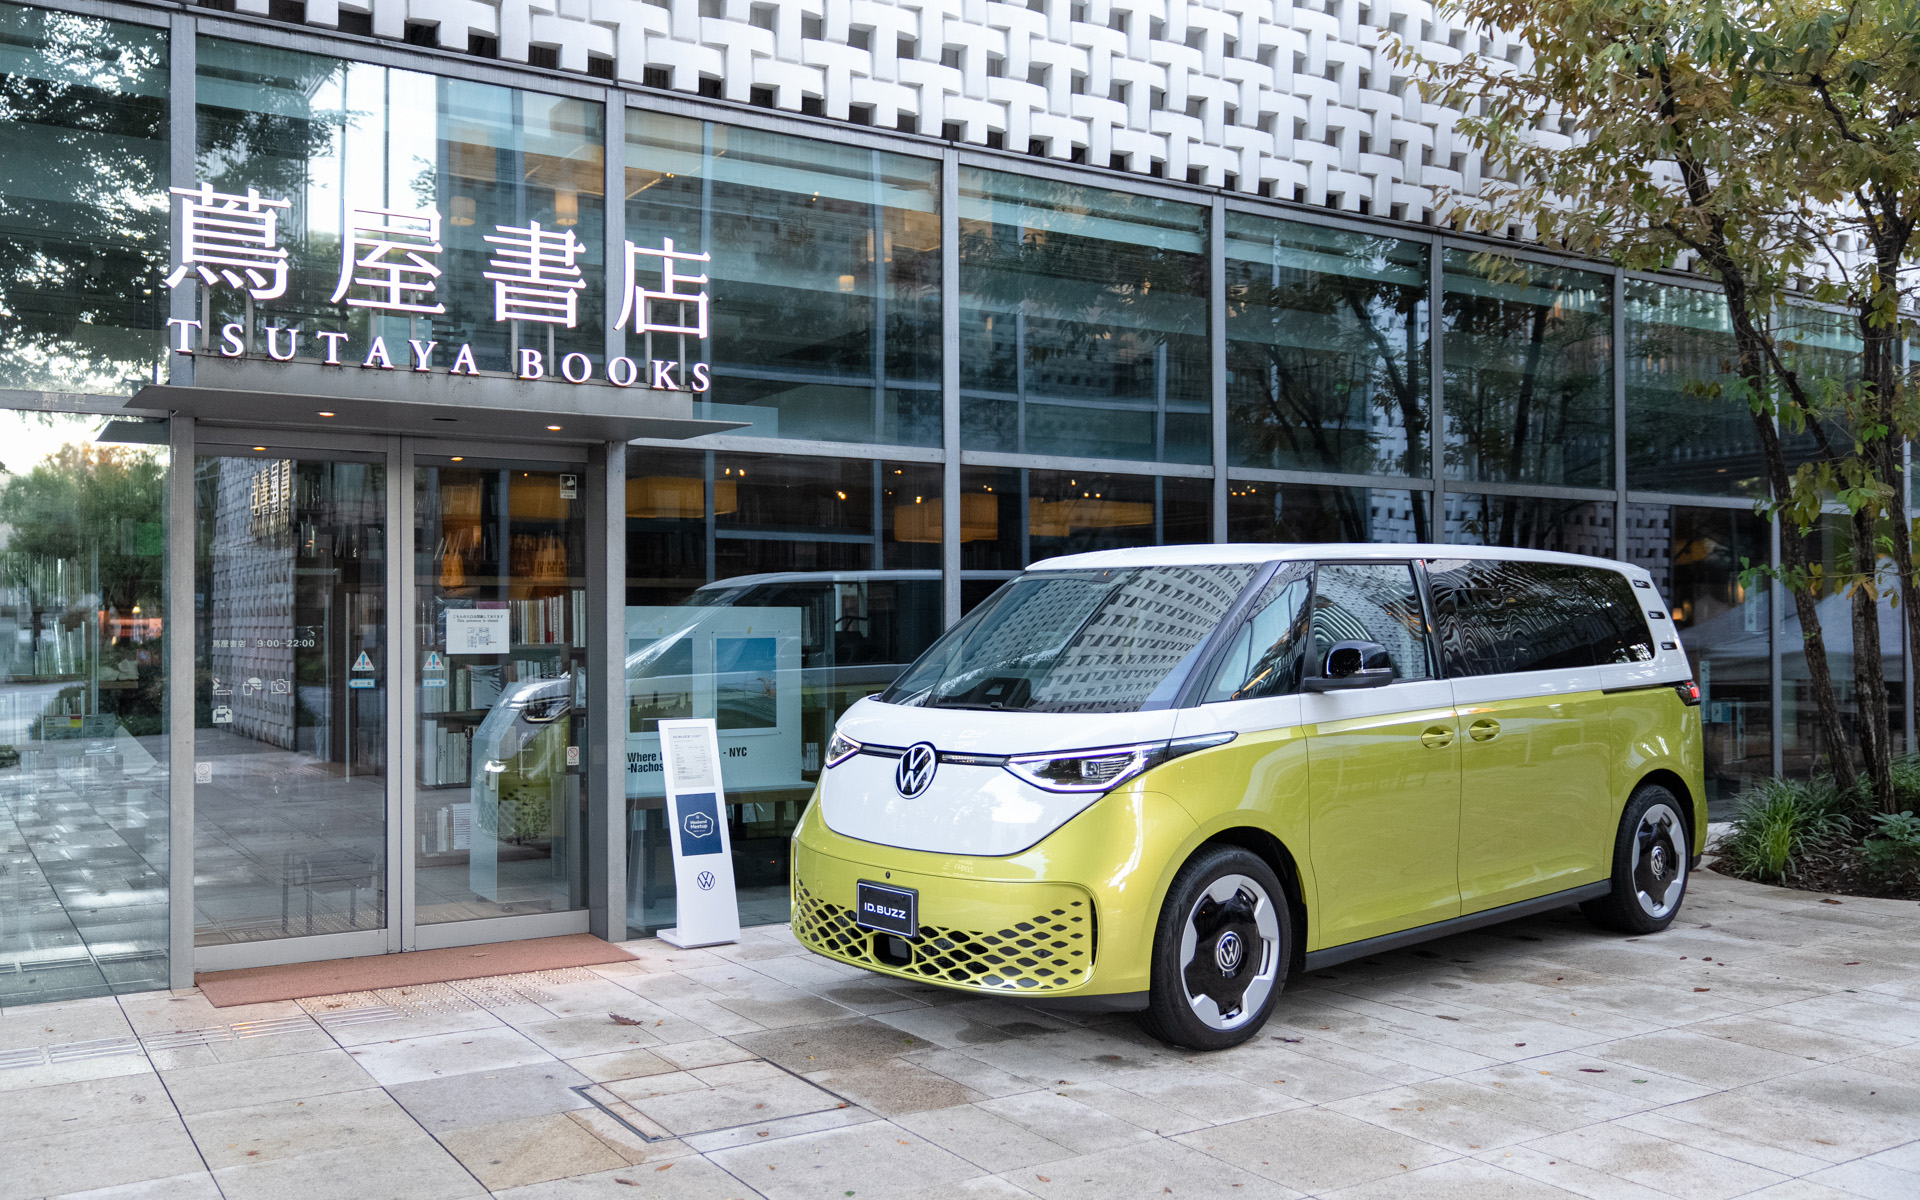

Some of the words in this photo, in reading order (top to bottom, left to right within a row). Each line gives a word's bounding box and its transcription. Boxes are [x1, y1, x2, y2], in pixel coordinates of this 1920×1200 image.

[163, 181, 711, 339] 蔦屋書店
[165, 317, 480, 377] TSUTAYA
[519, 347, 711, 393] BOOKS
[627, 752, 657, 763] Where
[729, 747, 747, 757] NYC
[864, 902, 907, 920] ID.BUZZ
